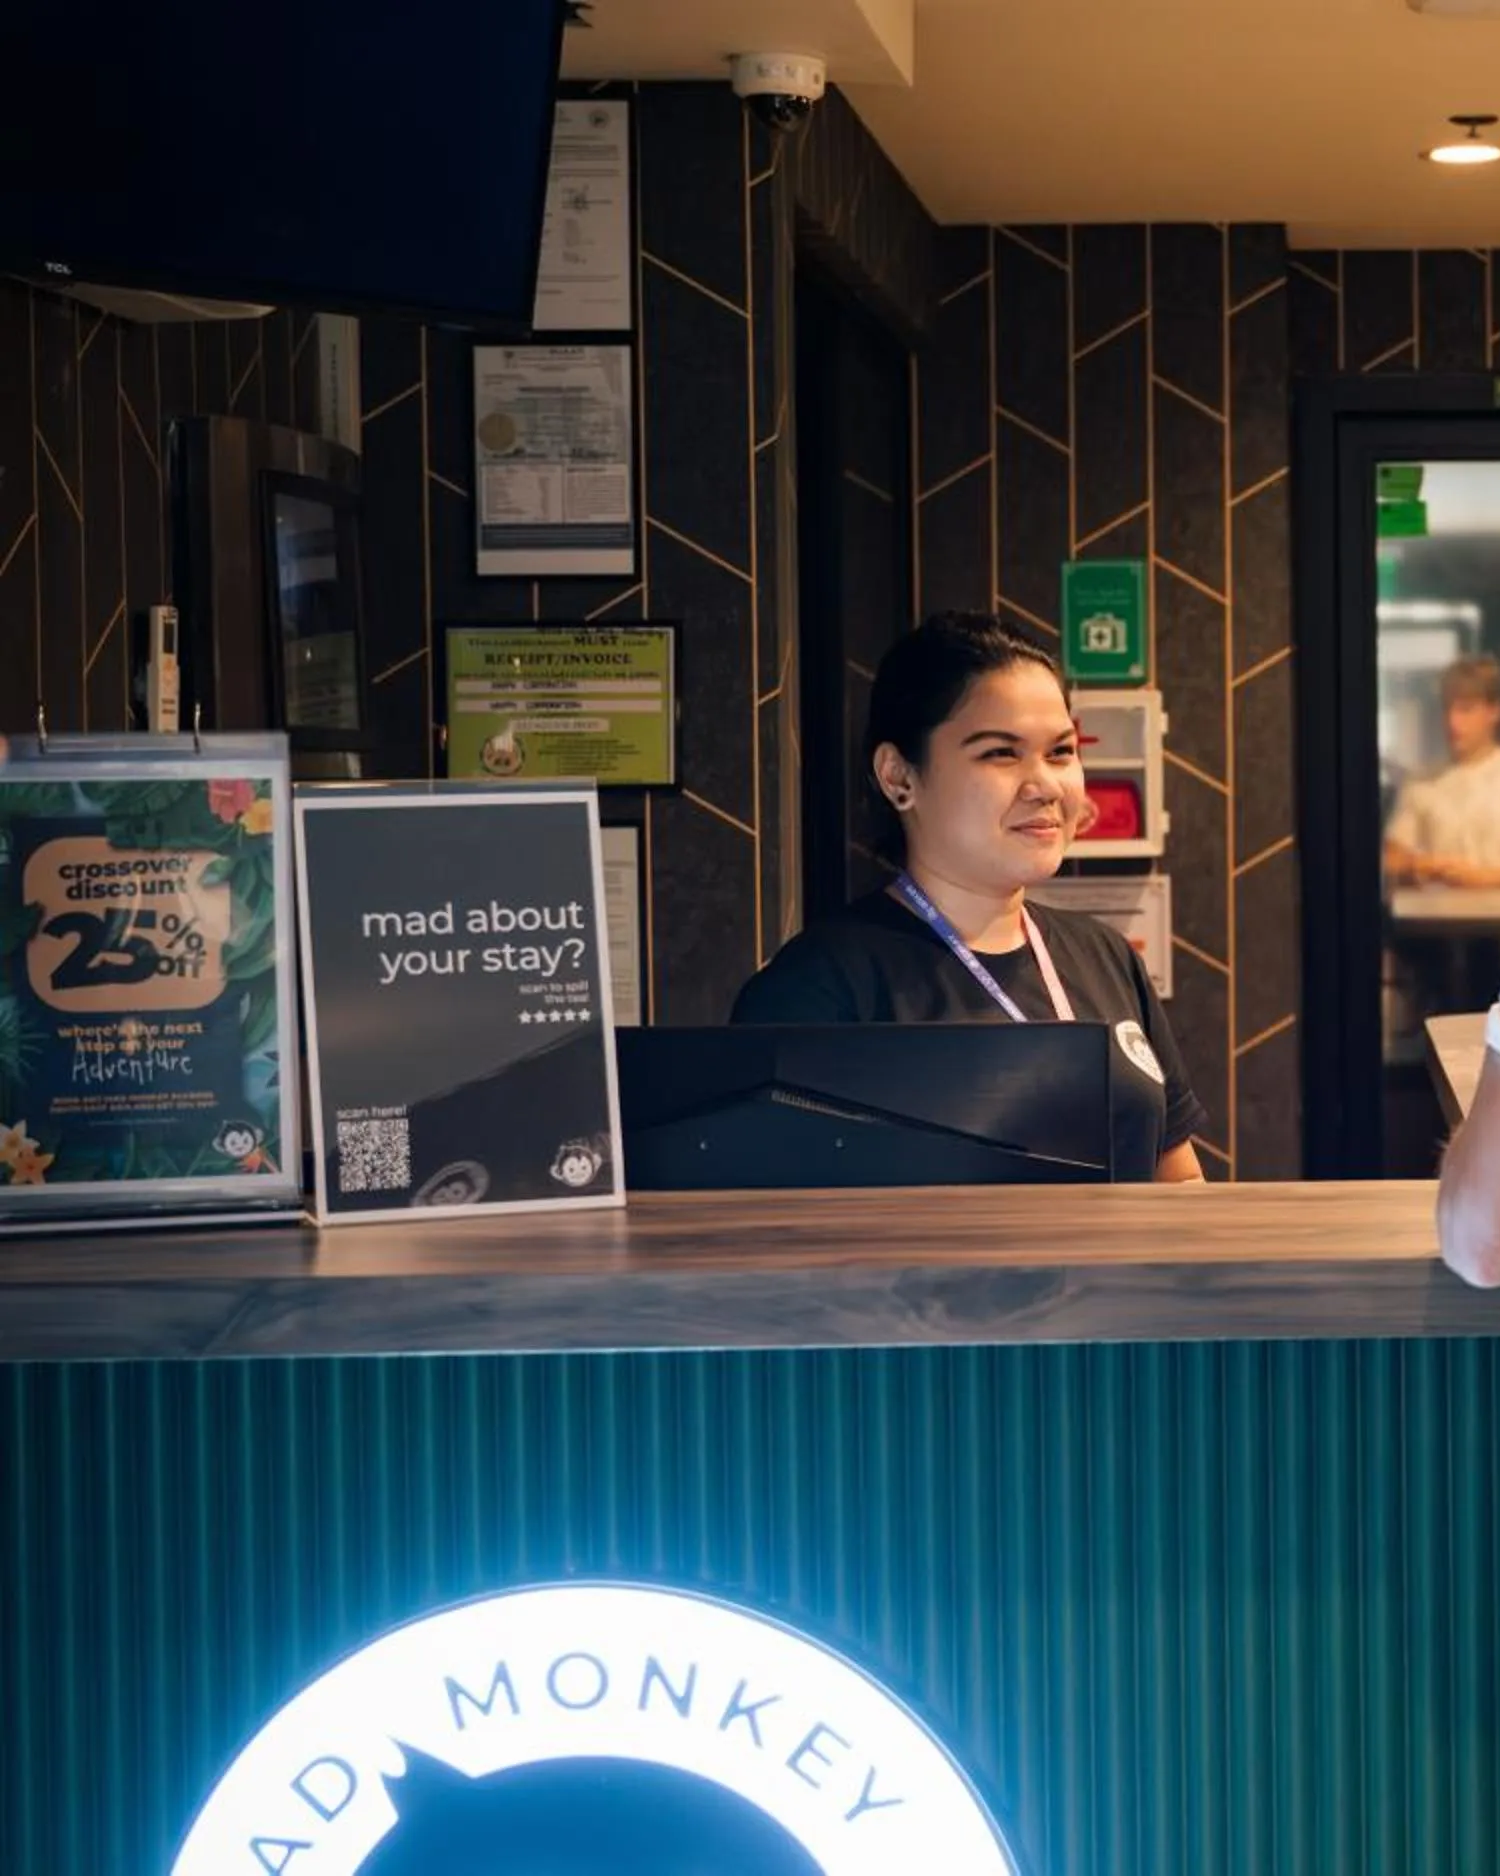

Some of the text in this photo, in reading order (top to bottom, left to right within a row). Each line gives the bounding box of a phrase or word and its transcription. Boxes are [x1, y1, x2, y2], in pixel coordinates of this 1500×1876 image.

[45, 262, 72, 275] TCL
[58, 856, 193, 881] crossover
[65, 875, 189, 900] discount
[361, 900, 586, 937] mad about
[156, 952, 207, 979] off
[379, 937, 586, 984] your stay?
[164, 1021, 205, 1036] next
[147, 1038, 187, 1053] your
[71, 1050, 194, 1086] Adventure
[337, 1108, 368, 1118] scan
[249, 1651, 906, 1876] AD MONKEY
